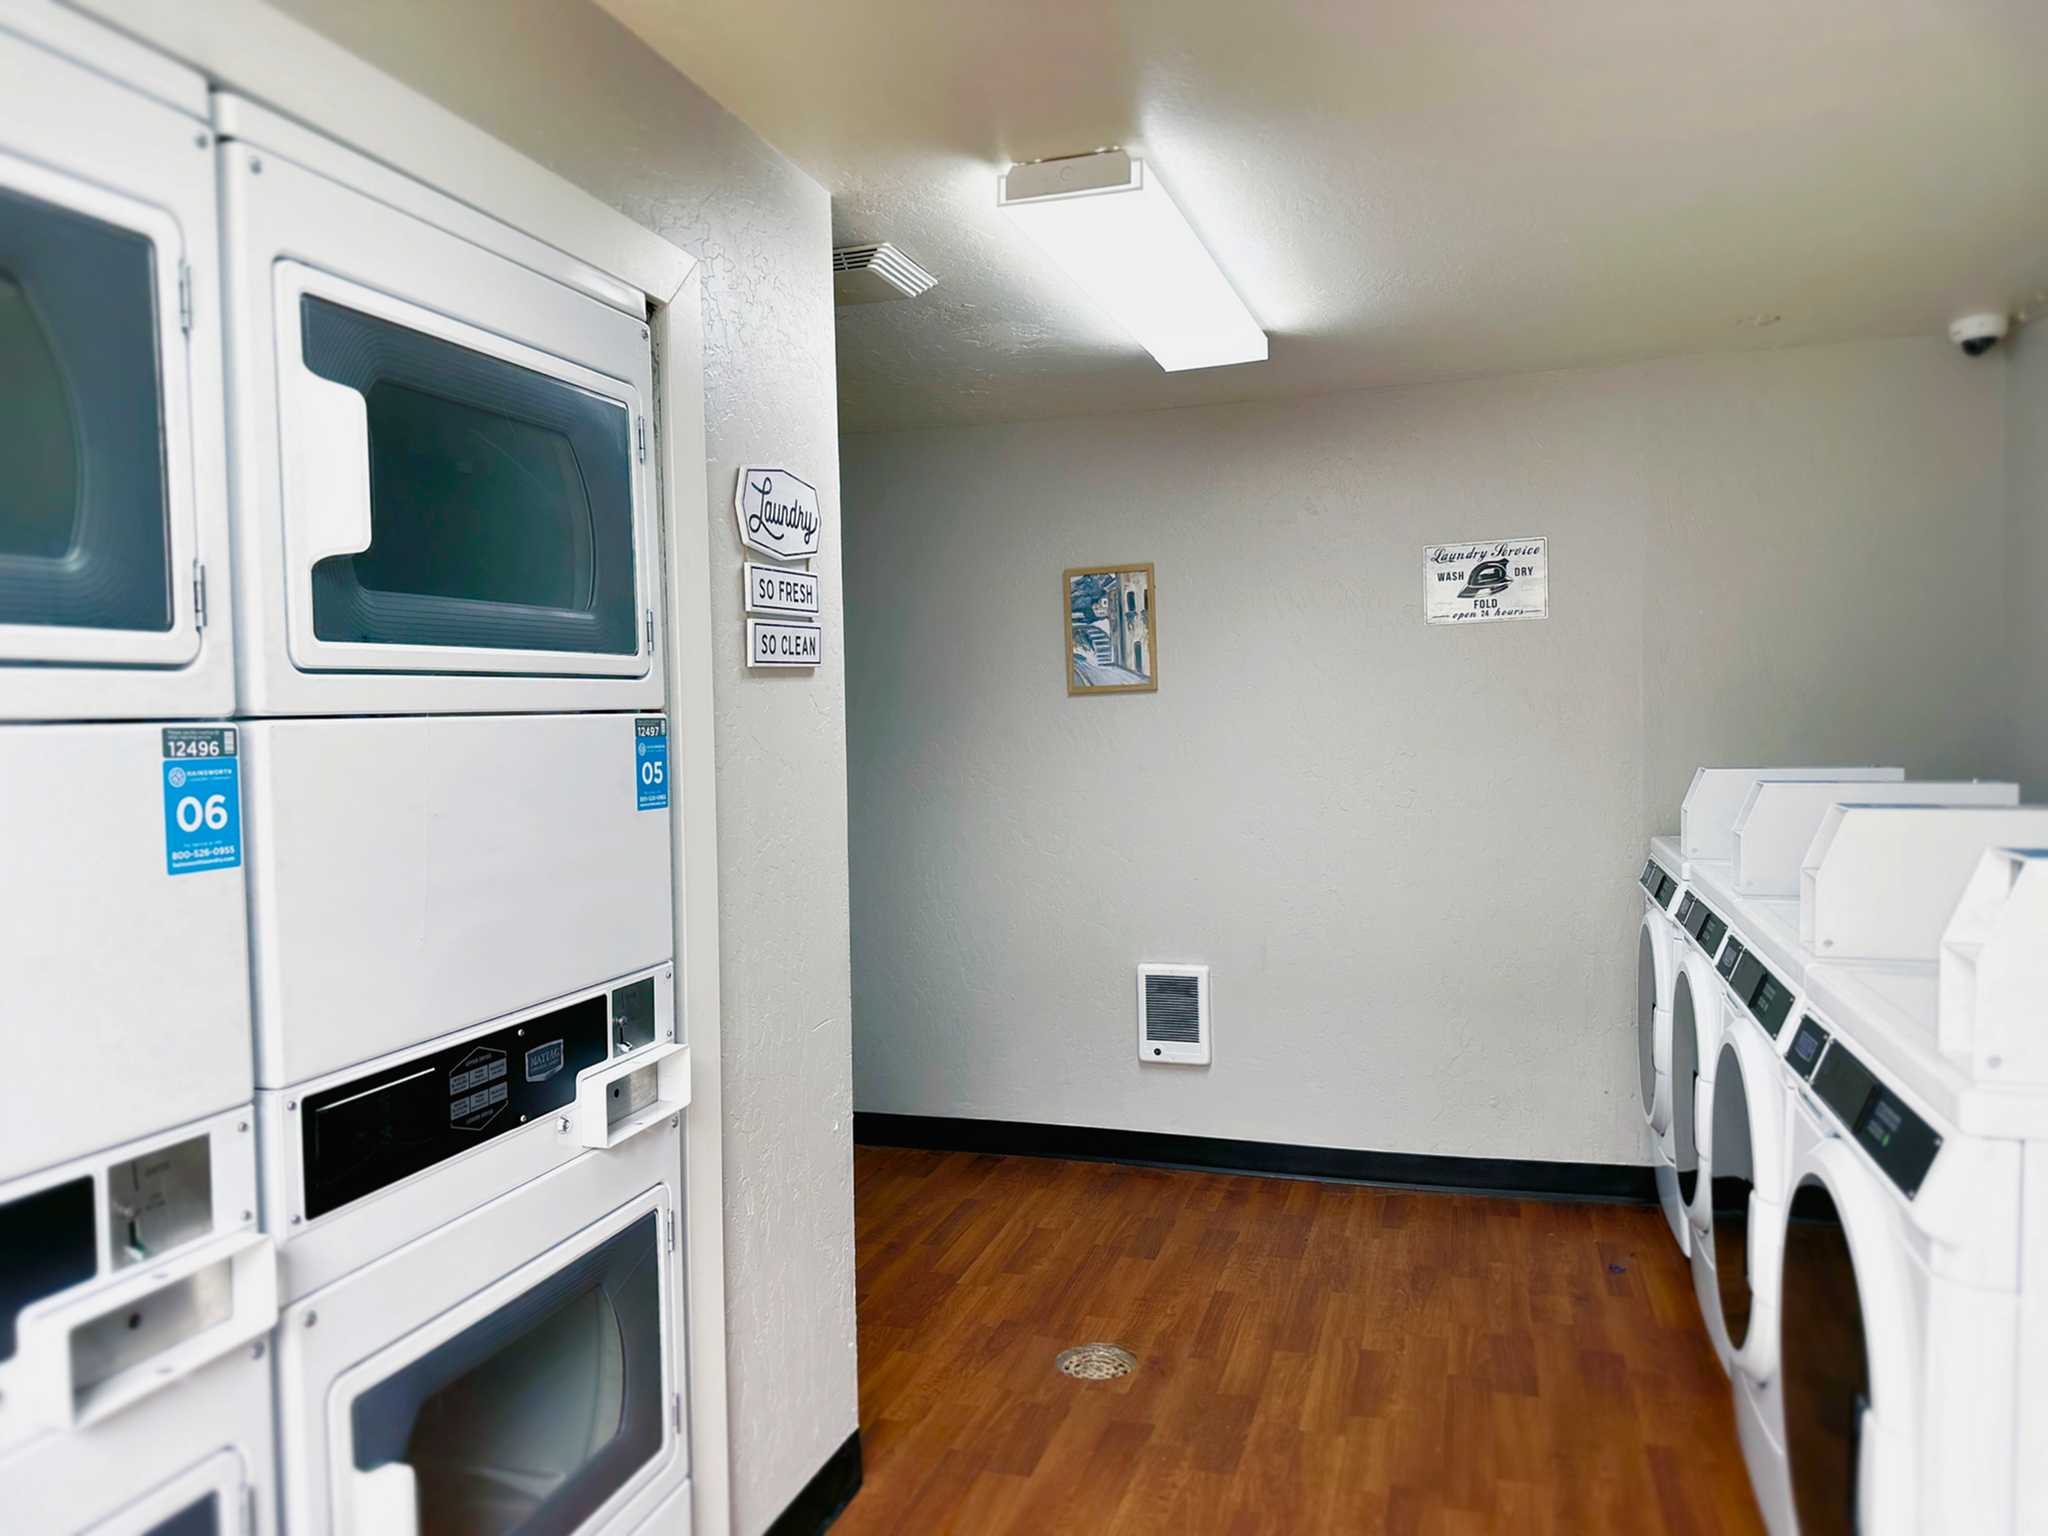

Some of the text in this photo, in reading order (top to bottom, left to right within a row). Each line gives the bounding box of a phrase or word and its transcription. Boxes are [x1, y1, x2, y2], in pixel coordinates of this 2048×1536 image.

[749, 477, 818, 545] Laundry
[1430, 542, 1540, 564] Laundry Service
[1437, 566, 1534, 582] WASH DRY
[759, 578, 813, 604] SO FRESH
[1452, 612, 1477, 620] open
[1494, 608, 1524, 617] hours
[1473, 599, 1498, 609] FOLD
[761, 634, 816, 656] SO CLEAN
[637, 726, 659, 737] 12497
[168, 740, 220, 757] 12496
[642, 761, 663, 785] 05
[176, 794, 228, 833] 06
[172, 845, 235, 861] 800-526-0955
[530, 1047, 560, 1067] MAYTAG
